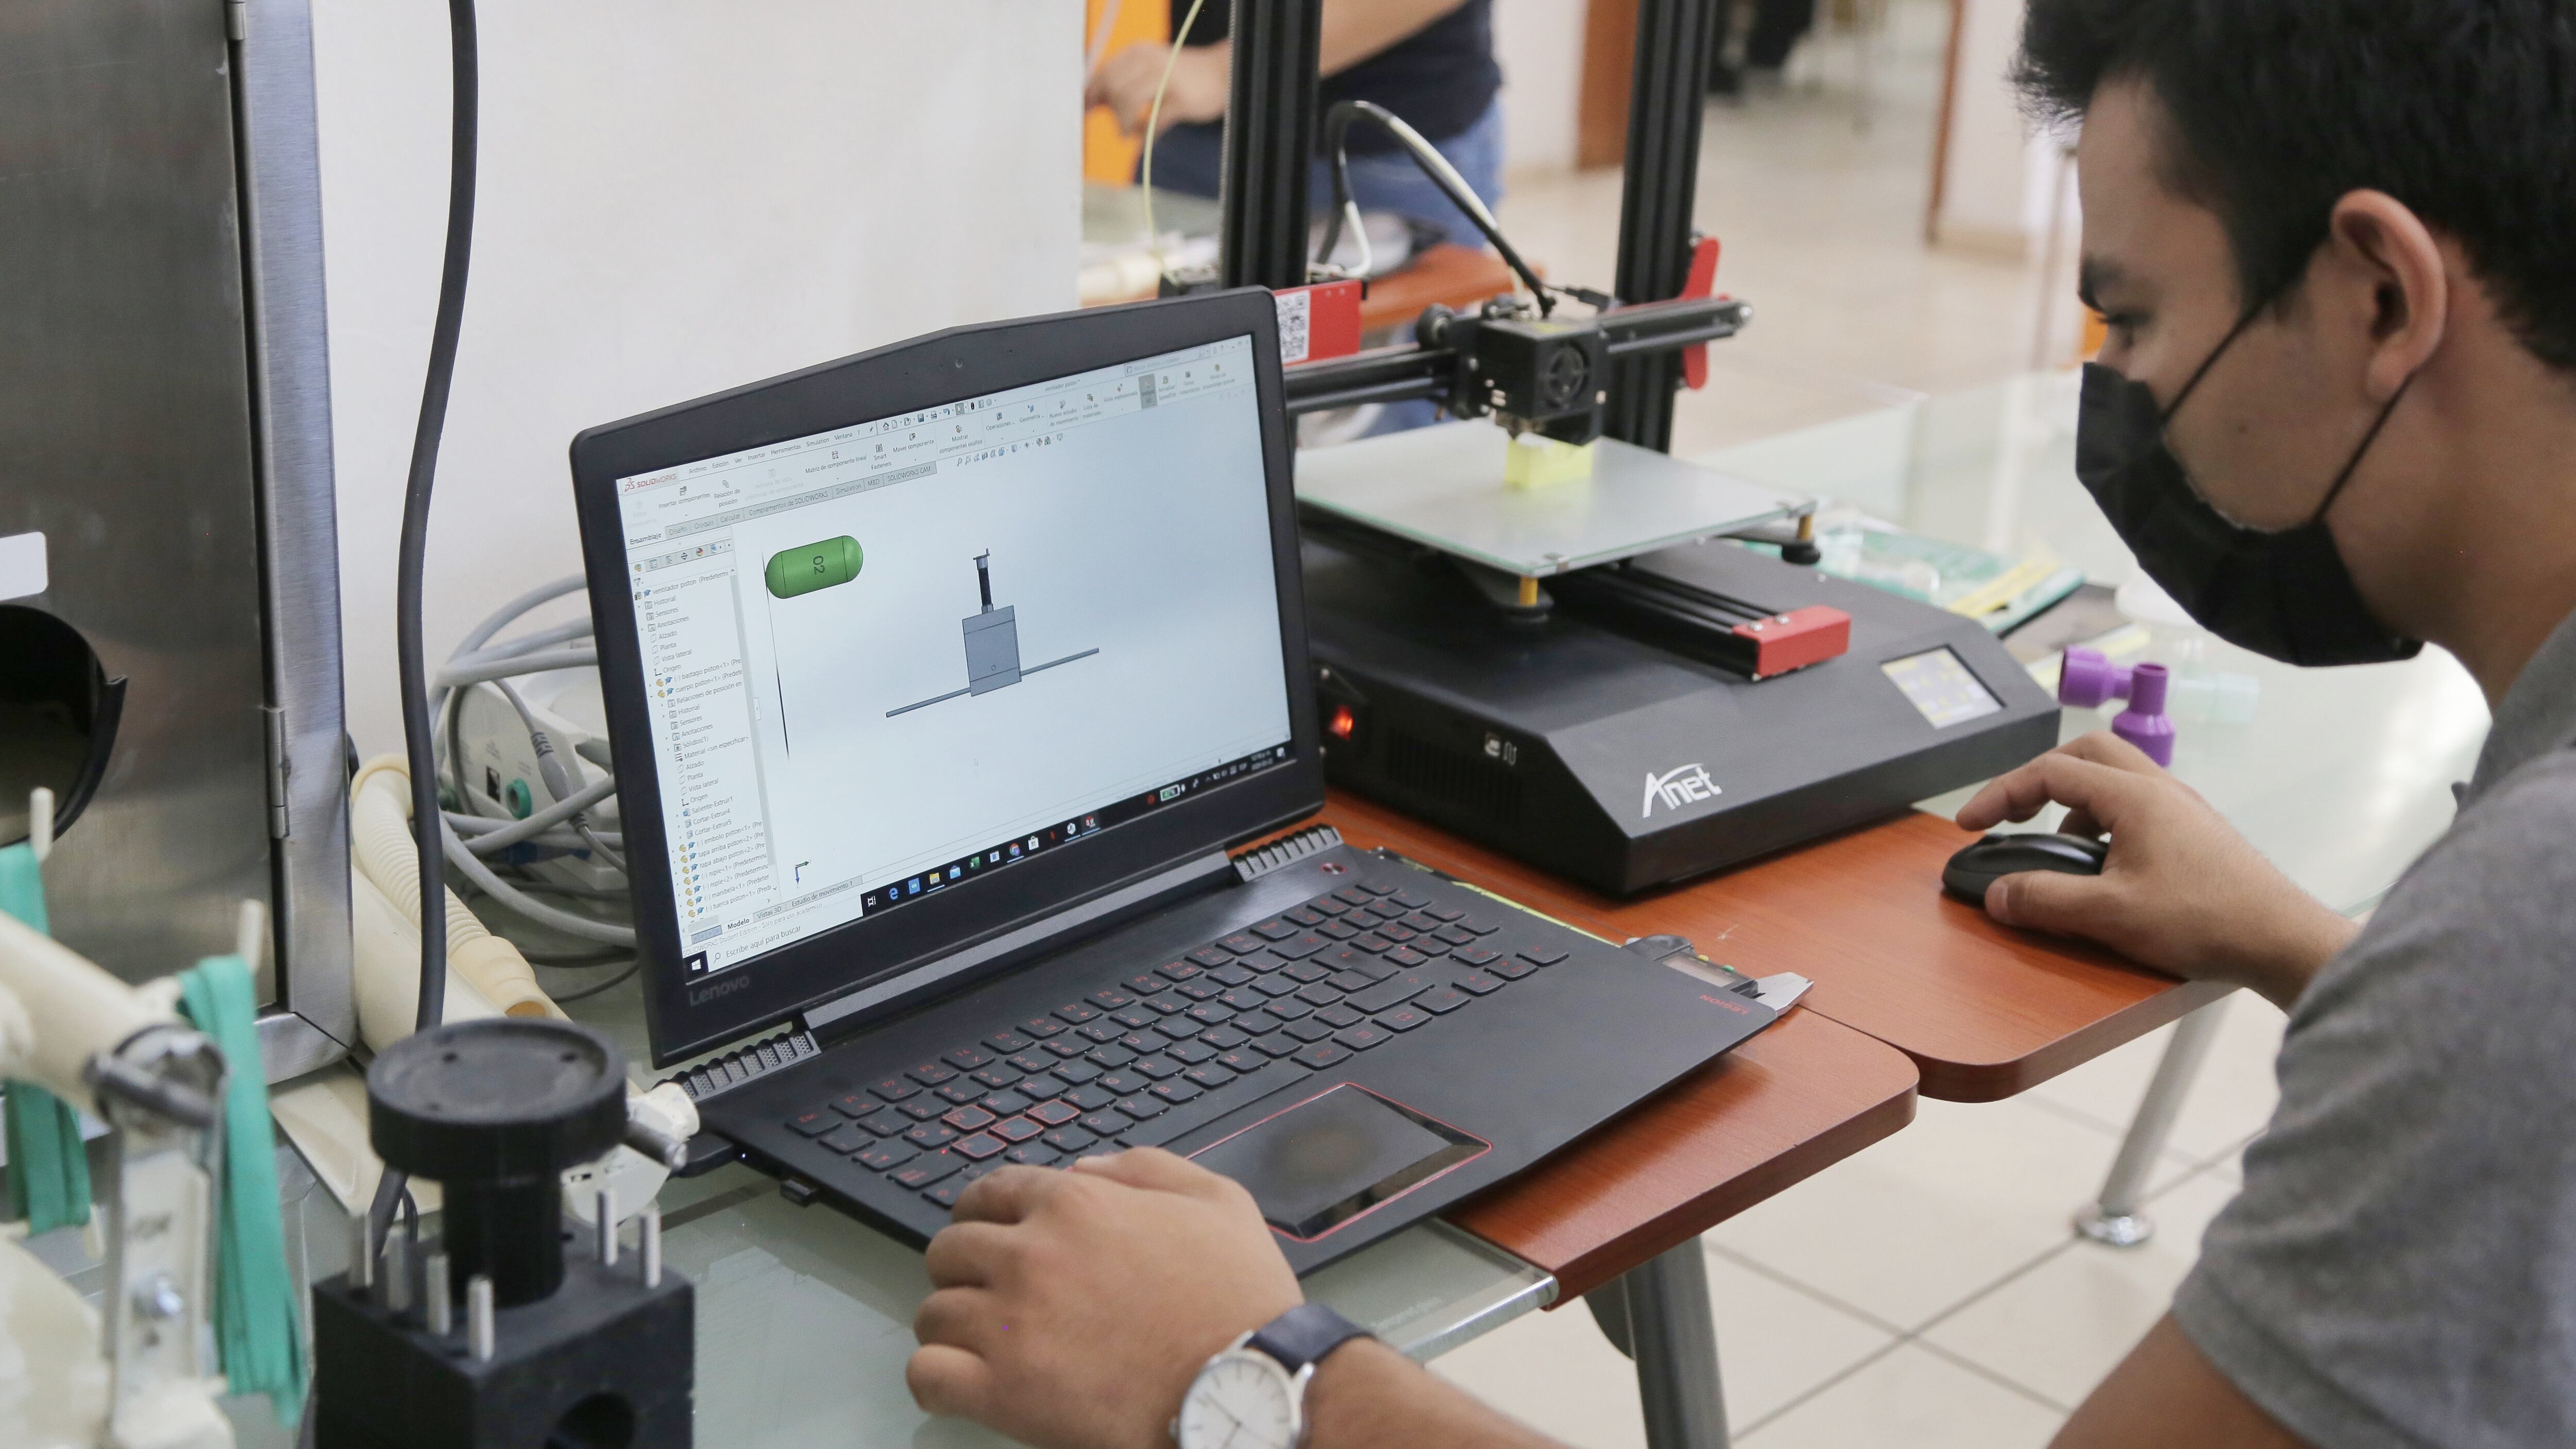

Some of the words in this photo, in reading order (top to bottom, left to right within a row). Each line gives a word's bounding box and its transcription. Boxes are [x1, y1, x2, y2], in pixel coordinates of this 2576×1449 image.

[986, 420, 1010, 431] Operaciones
[805, 436, 829, 447] Simulation
[893, 445, 907, 453] Mover
[907, 438, 934, 451] componente
[747, 451, 766, 461] Insertar
[770, 443, 801, 455] Herramientas
[873, 452, 887, 461] Smart
[688, 465, 707, 474] Archivo
[711, 459, 729, 469] Edición
[805, 465, 820, 474] Matriz
[827, 457, 855, 470] componente
[855, 454, 867, 462] lineal
[871, 461, 892, 471] Fasteners
[636, 472, 677, 488] SOLIDWORKS
[887, 468, 919, 482] SOLIDWORKS
[919, 465, 931, 474] CAM
[714, 489, 733, 499] Relación
[835, 482, 861, 495] Simulation
[658, 499, 677, 509] Insertar
[677, 492, 710, 505] componentes
[749, 501, 786, 517] Complementos
[794, 490, 828, 505] SOLIDWORKS
[694, 519, 714, 530] Croquis
[720, 512, 741, 523] Calcular
[669, 525, 687, 536] Diseño
[630, 532, 662, 546] Ensamblaje
[651, 582, 680, 595] ventilador
[653, 594, 676, 607] Historial
[655, 606, 679, 618] Sensores
[656, 614, 689, 629] Anotaciones
[658, 629, 677, 640] Alzado
[659, 641, 677, 652] Planta
[661, 653, 674, 663] Vista
[675, 648, 692, 659] lateral
[663, 662, 681, 674] Origen
[681, 668, 703, 681] bastago
[703, 660, 730, 675] piston<1>
[730, 657, 742, 667] (Pre
[675, 683, 694, 694] cuerpo
[694, 674, 721, 689] piston<1>
[676, 691, 704, 705] Relaciones
[704, 688, 712, 696] de
[677, 703, 700, 716] Historial
[679, 714, 703, 727] Sensores
[681, 722, 713, 738] Anotaciones
[682, 735, 709, 749] Sólidos(1)
[684, 747, 706, 760] Material
[718, 734, 749, 751] especificar>
[685, 759, 704, 771] Alzado
[687, 771, 704, 782] Planta
[688, 782, 702, 793] Vista
[702, 777, 719, 789] lateral
[1642, 763, 1723, 818] Anet
[690, 792, 708, 805] Origen
[692, 807, 731, 826] Cortar-Extruir4
[694, 818, 732, 837] Cortar-Extruir5
[704, 832, 724, 845] embolo
[725, 824, 751, 839] piston<1>
[752, 820, 763, 829] (Pre
[698, 849, 710, 859] tapa
[710, 843, 726, 854] arriba
[726, 834, 753, 849] piston<2>
[753, 830, 764, 840] (Pre
[700, 860, 711, 870] tapa
[711, 854, 727, 866] abajo
[728, 845, 754, 860] piston<2>
[754, 841, 766, 850] (Pre
[730, 889, 755, 905] piston<1>
[791, 894, 810, 907] Estudio
[811, 892, 818, 900] de
[818, 881, 849, 898] movimiento
[757, 908, 773, 919] Vistas
[773, 905, 782, 914] 3D
[682, 939, 718, 957] SOLIDWORKS
[718, 931, 739, 944] Student
[774, 915, 786, 926] para
[795, 901, 822, 916] académico
[727, 916, 750, 930] Modelo
[725, 943, 750, 958] Escribe
[750, 937, 765, 951] aquí
[765, 934, 780, 945] para
[780, 924, 802, 938] buscar
[689, 975, 750, 1007] Lenovo
